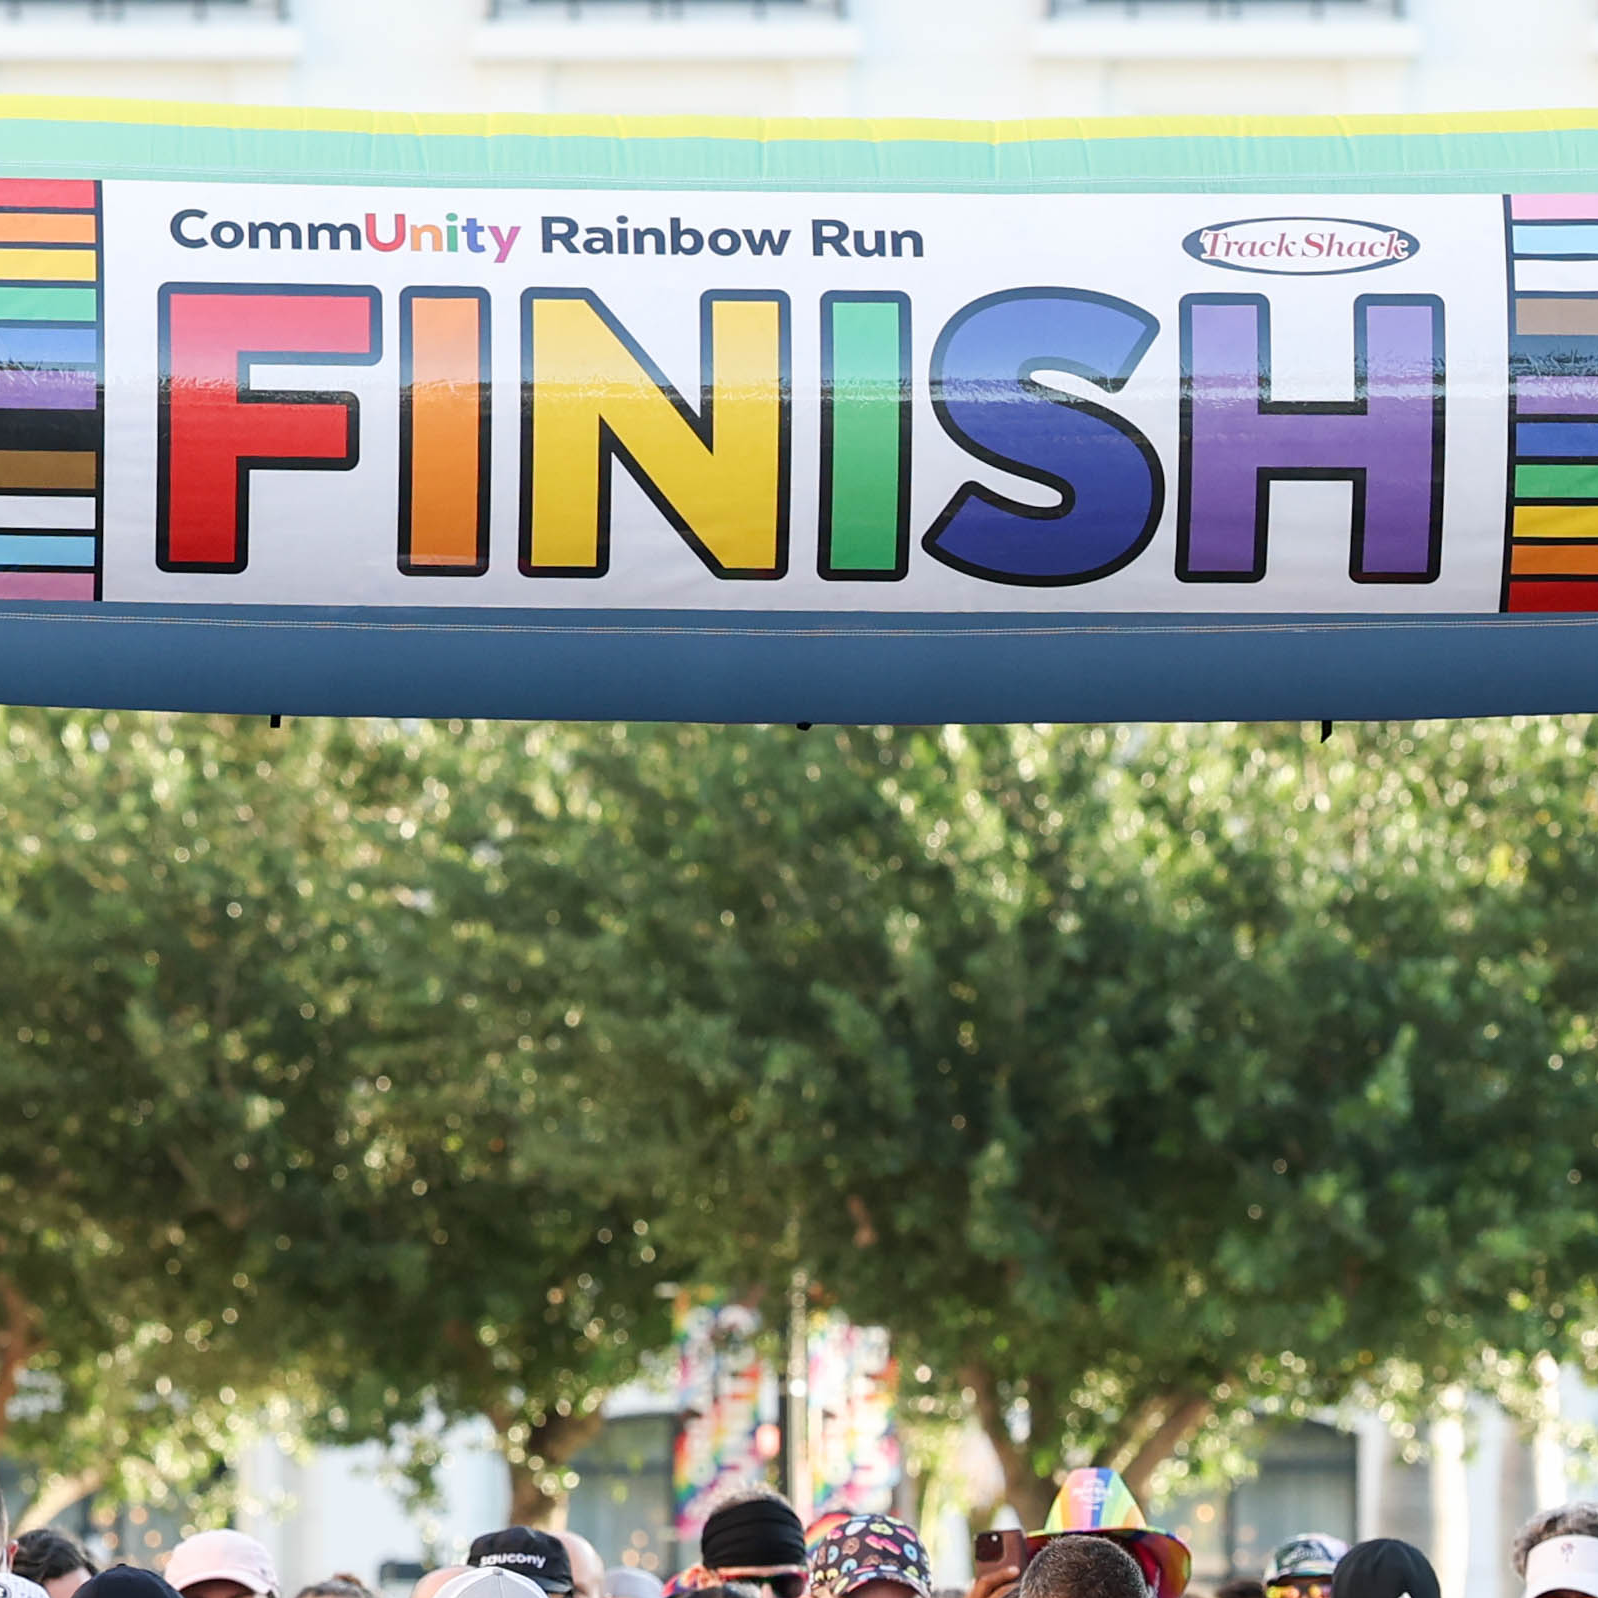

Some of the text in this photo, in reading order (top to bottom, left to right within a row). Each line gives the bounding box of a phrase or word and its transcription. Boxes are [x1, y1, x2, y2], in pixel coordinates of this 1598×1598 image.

[169, 208, 925, 264] CommUnity Rainbow Run
[1200, 229, 1410, 262] Track Shack
[157, 282, 1445, 588] FINISH
[480, 1552, 546, 1568] saucony
